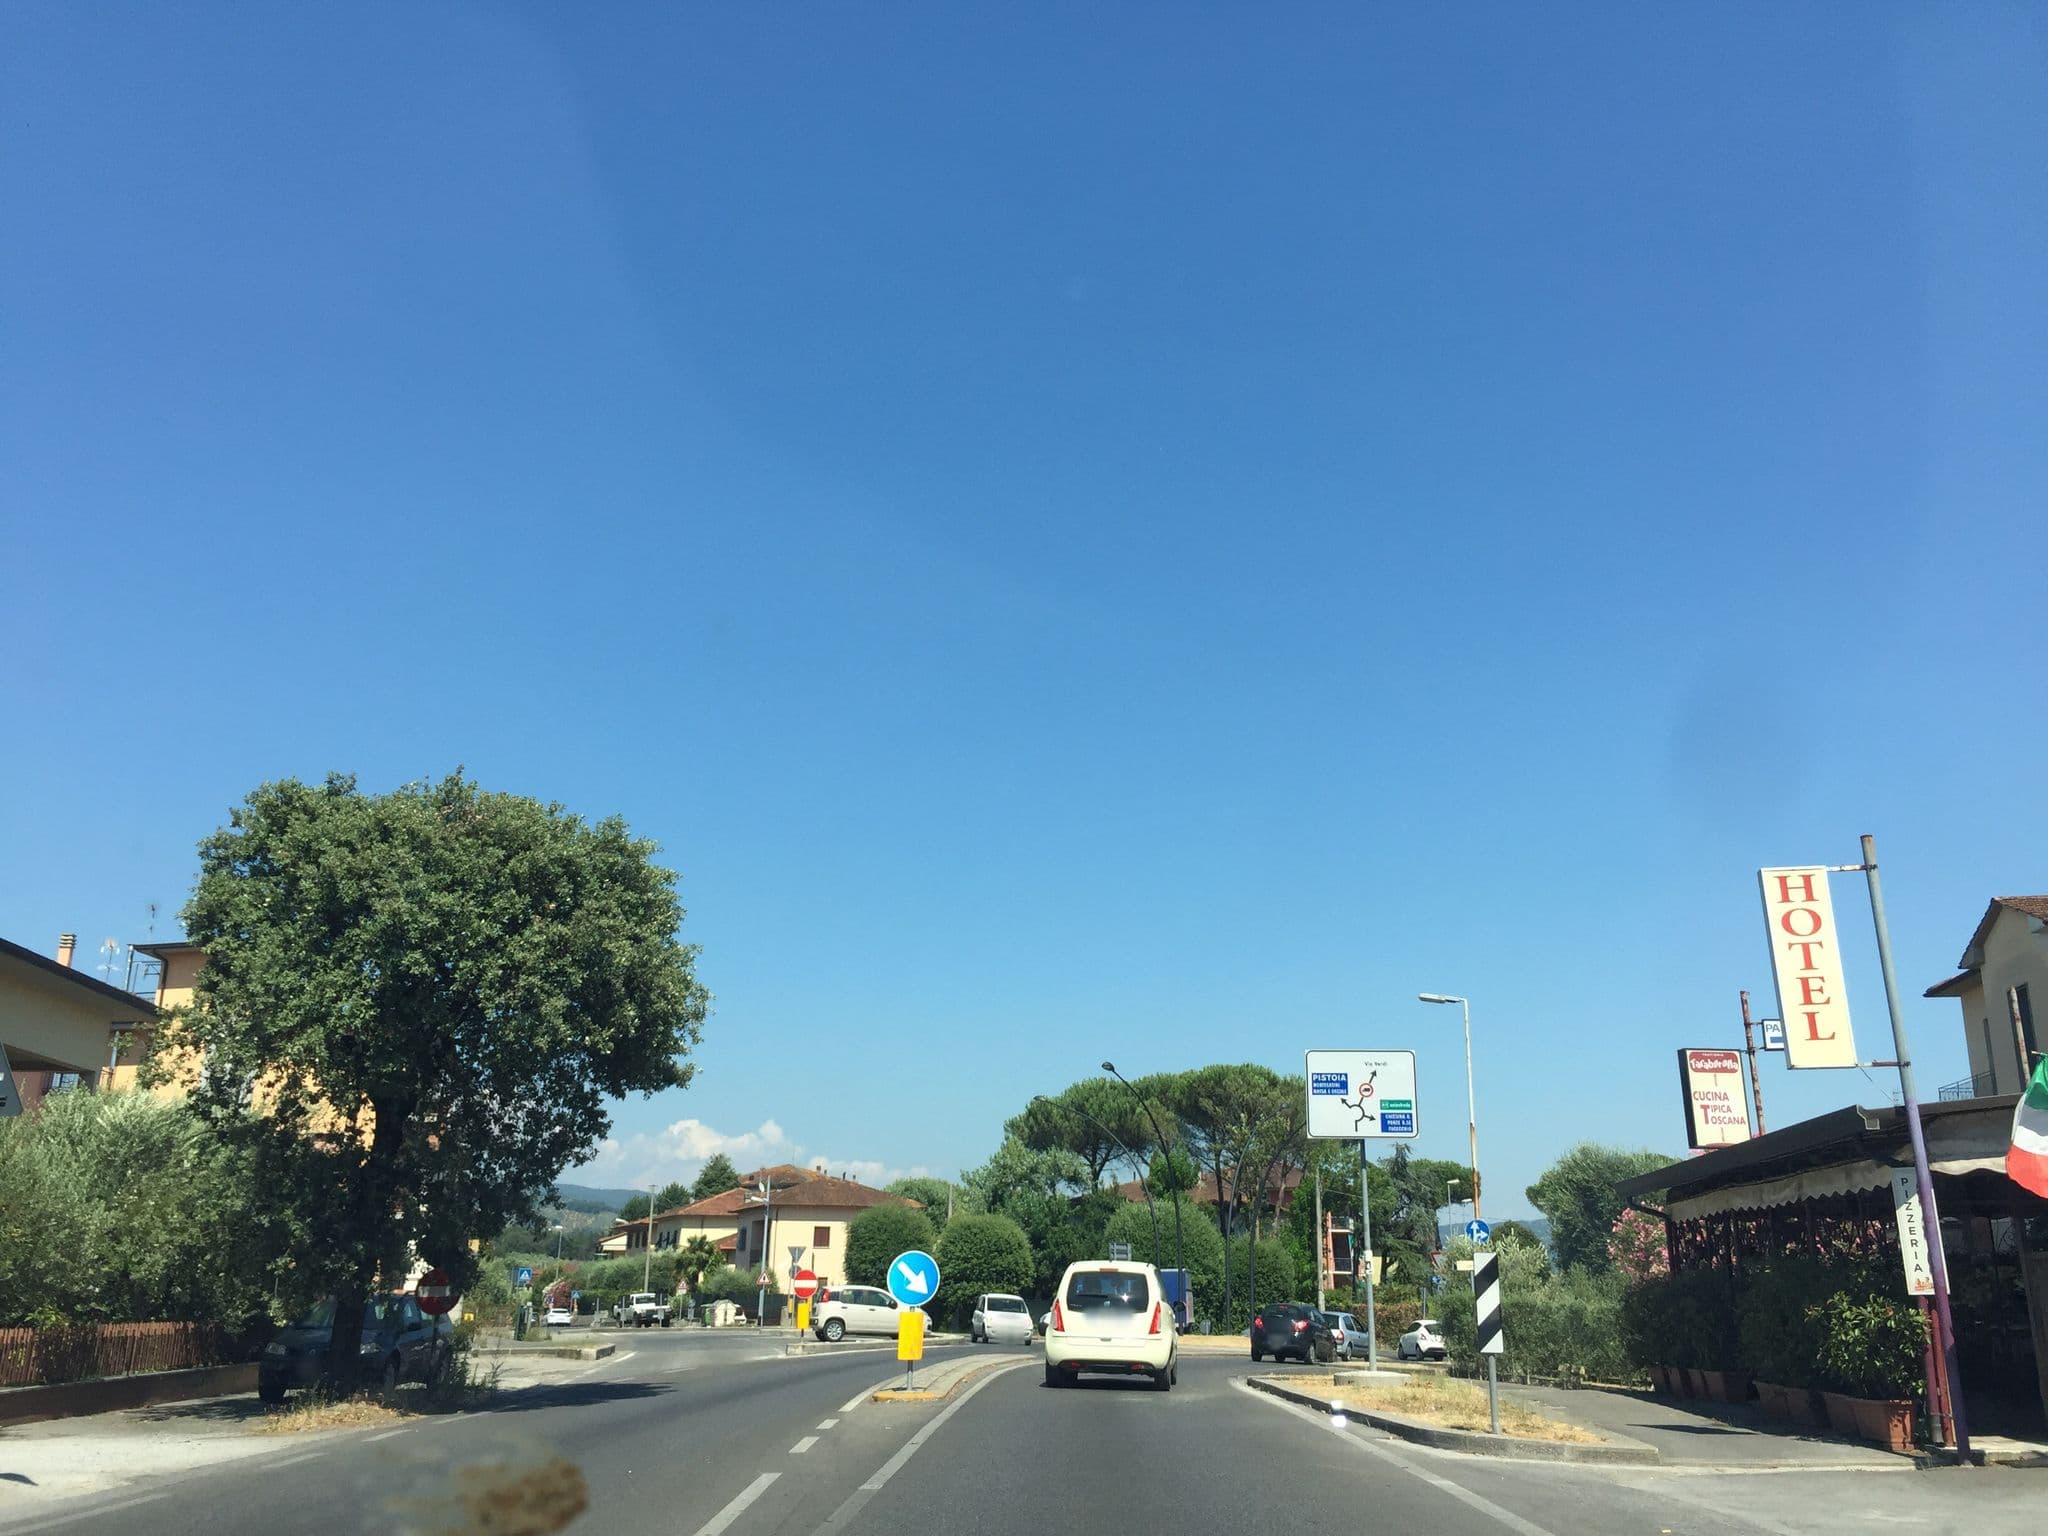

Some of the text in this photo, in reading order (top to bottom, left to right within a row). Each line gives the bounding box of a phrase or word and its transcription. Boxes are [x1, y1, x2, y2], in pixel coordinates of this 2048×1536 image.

[1774, 874, 1835, 1041] HOTEL
[1692, 1090, 1730, 1102] CUCINA
[1901, 1177, 1923, 1273] PIZZERIA
